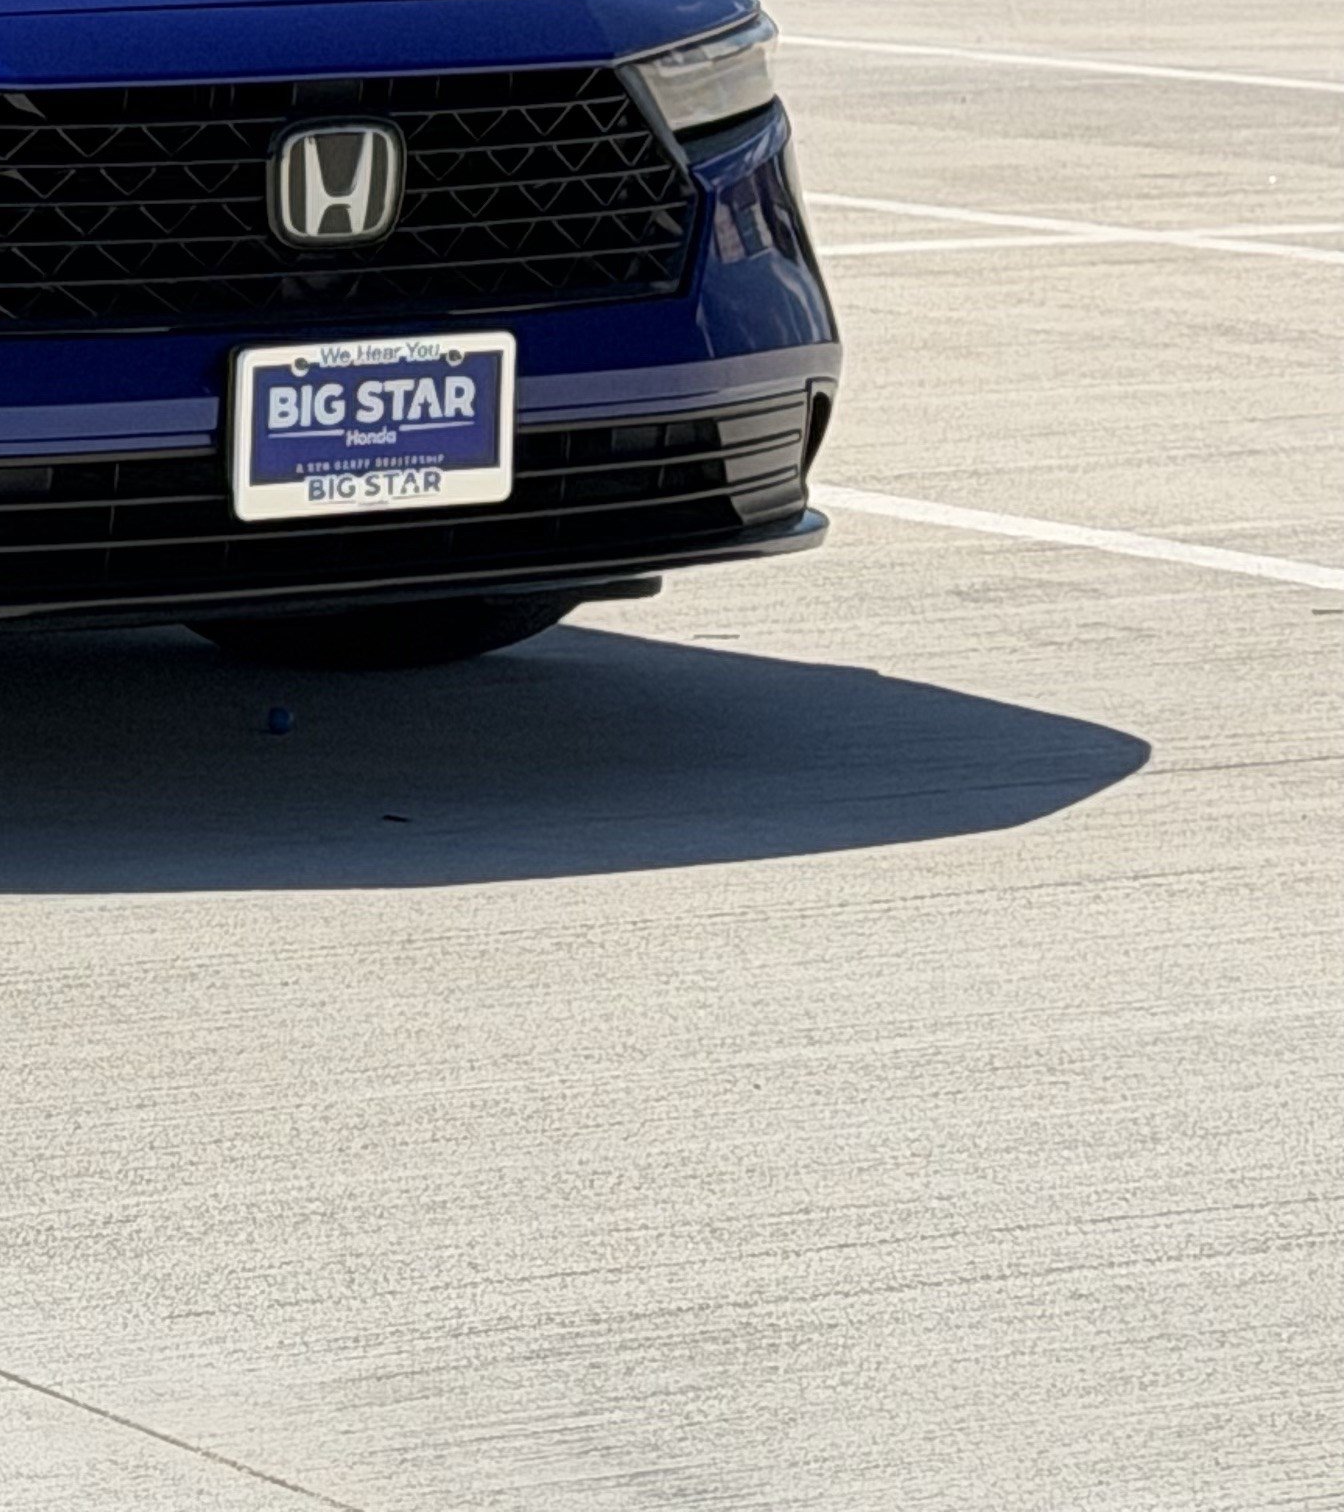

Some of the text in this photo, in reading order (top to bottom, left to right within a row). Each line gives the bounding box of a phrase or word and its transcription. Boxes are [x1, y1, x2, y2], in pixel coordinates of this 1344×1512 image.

[320, 341, 440, 364] We Hear You
[267, 376, 476, 430] BIG STAR
[345, 426, 397, 447] Honda
[308, 471, 442, 501] BIG STAR
